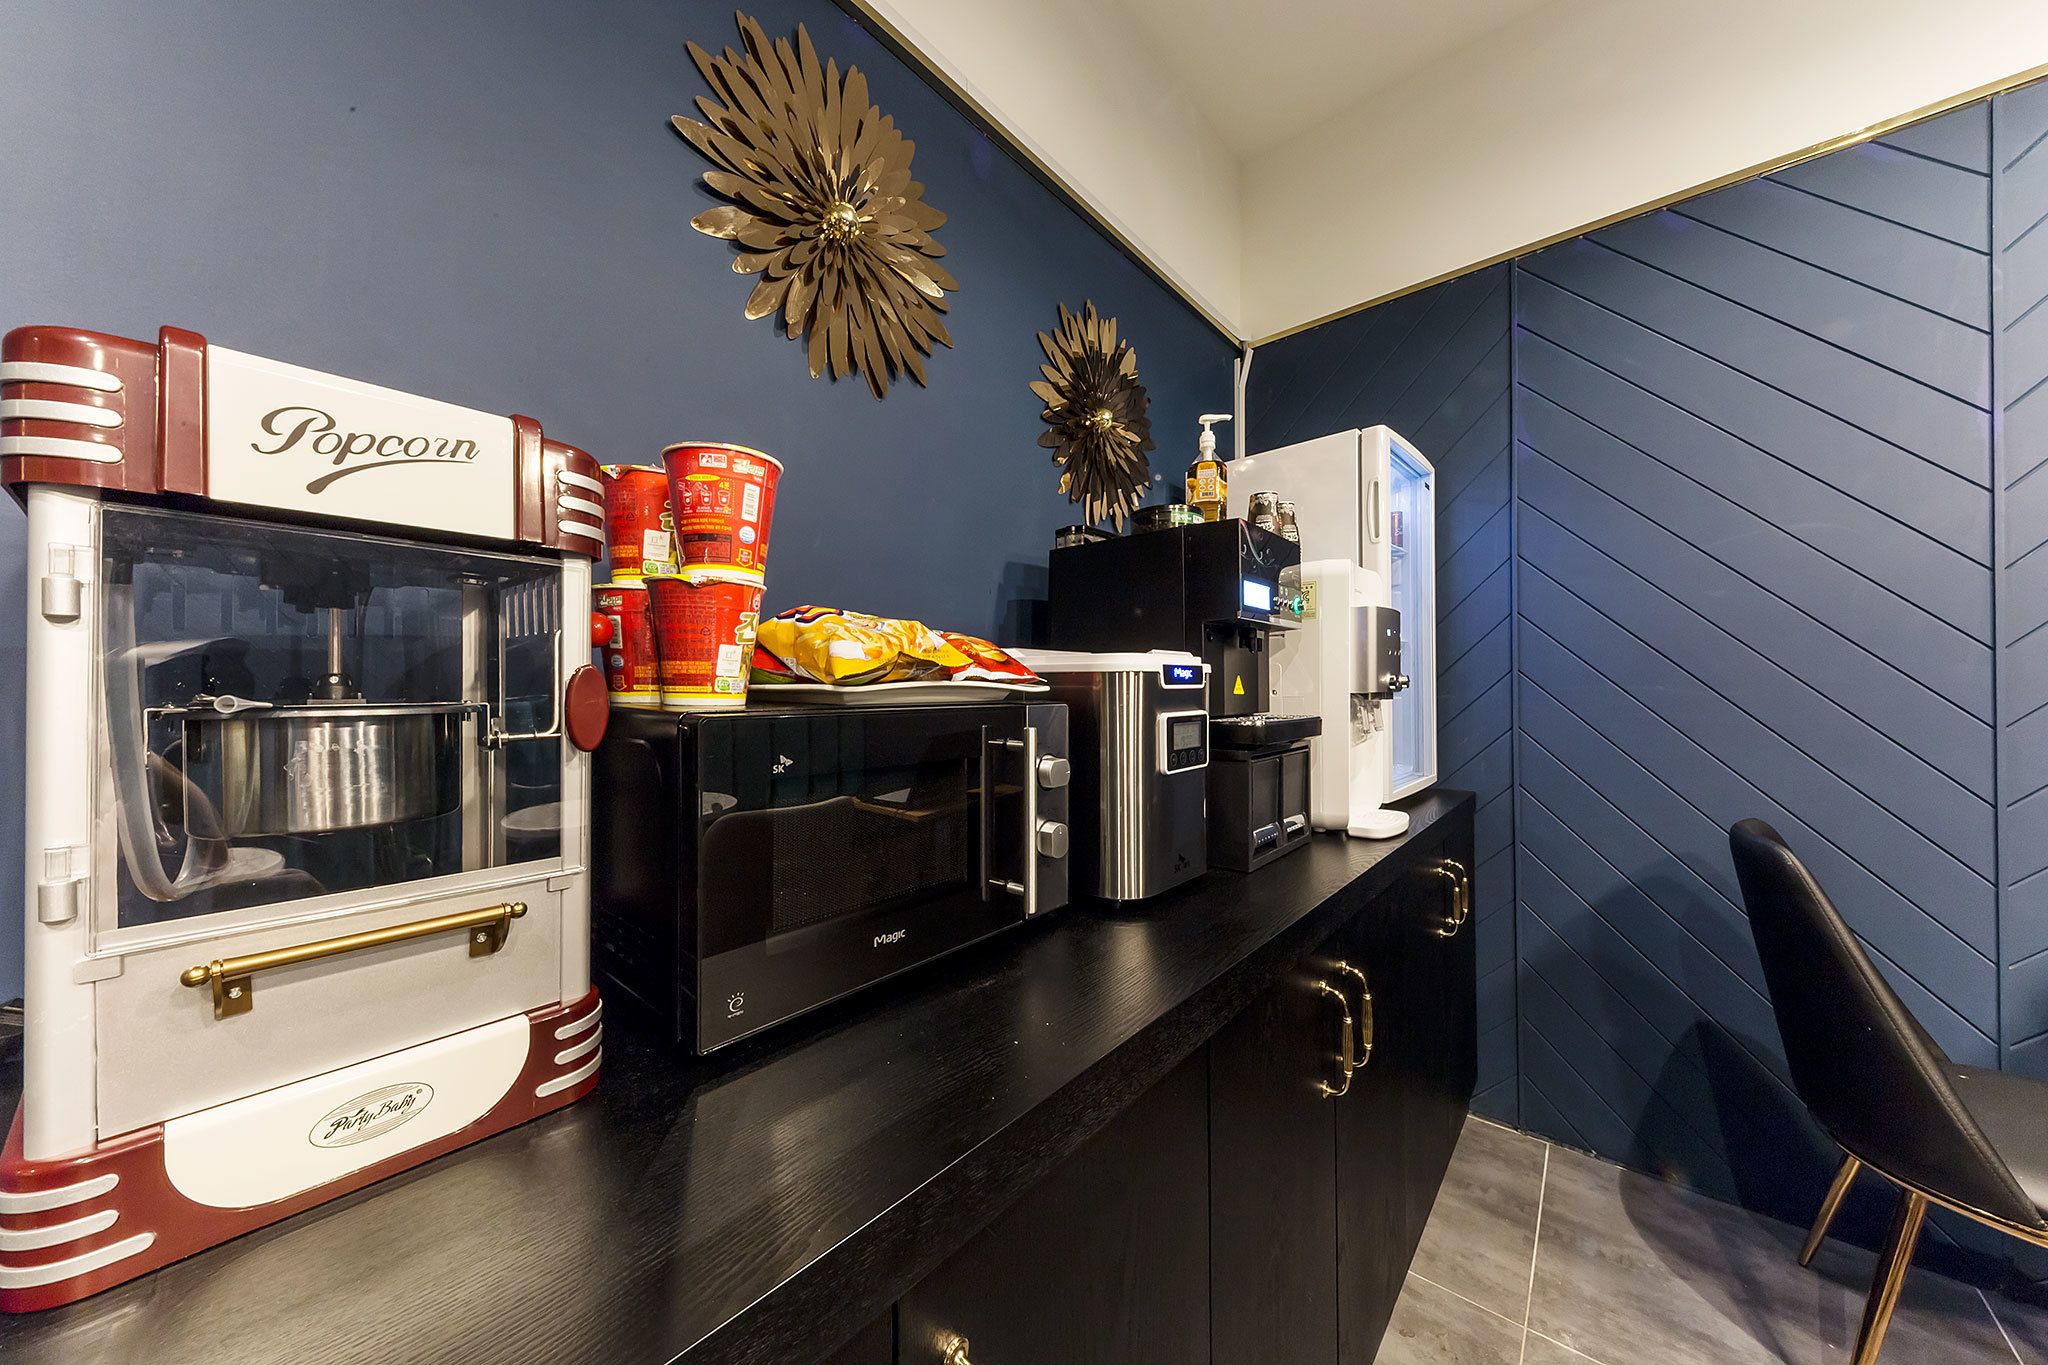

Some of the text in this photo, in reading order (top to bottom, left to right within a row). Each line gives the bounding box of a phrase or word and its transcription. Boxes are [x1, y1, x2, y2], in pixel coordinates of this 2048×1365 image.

[251, 406, 480, 495] Popcorn
[773, 764, 786, 774] SK
[873, 928, 906, 948] Magic
[324, 1094, 416, 1139] Party Baby
